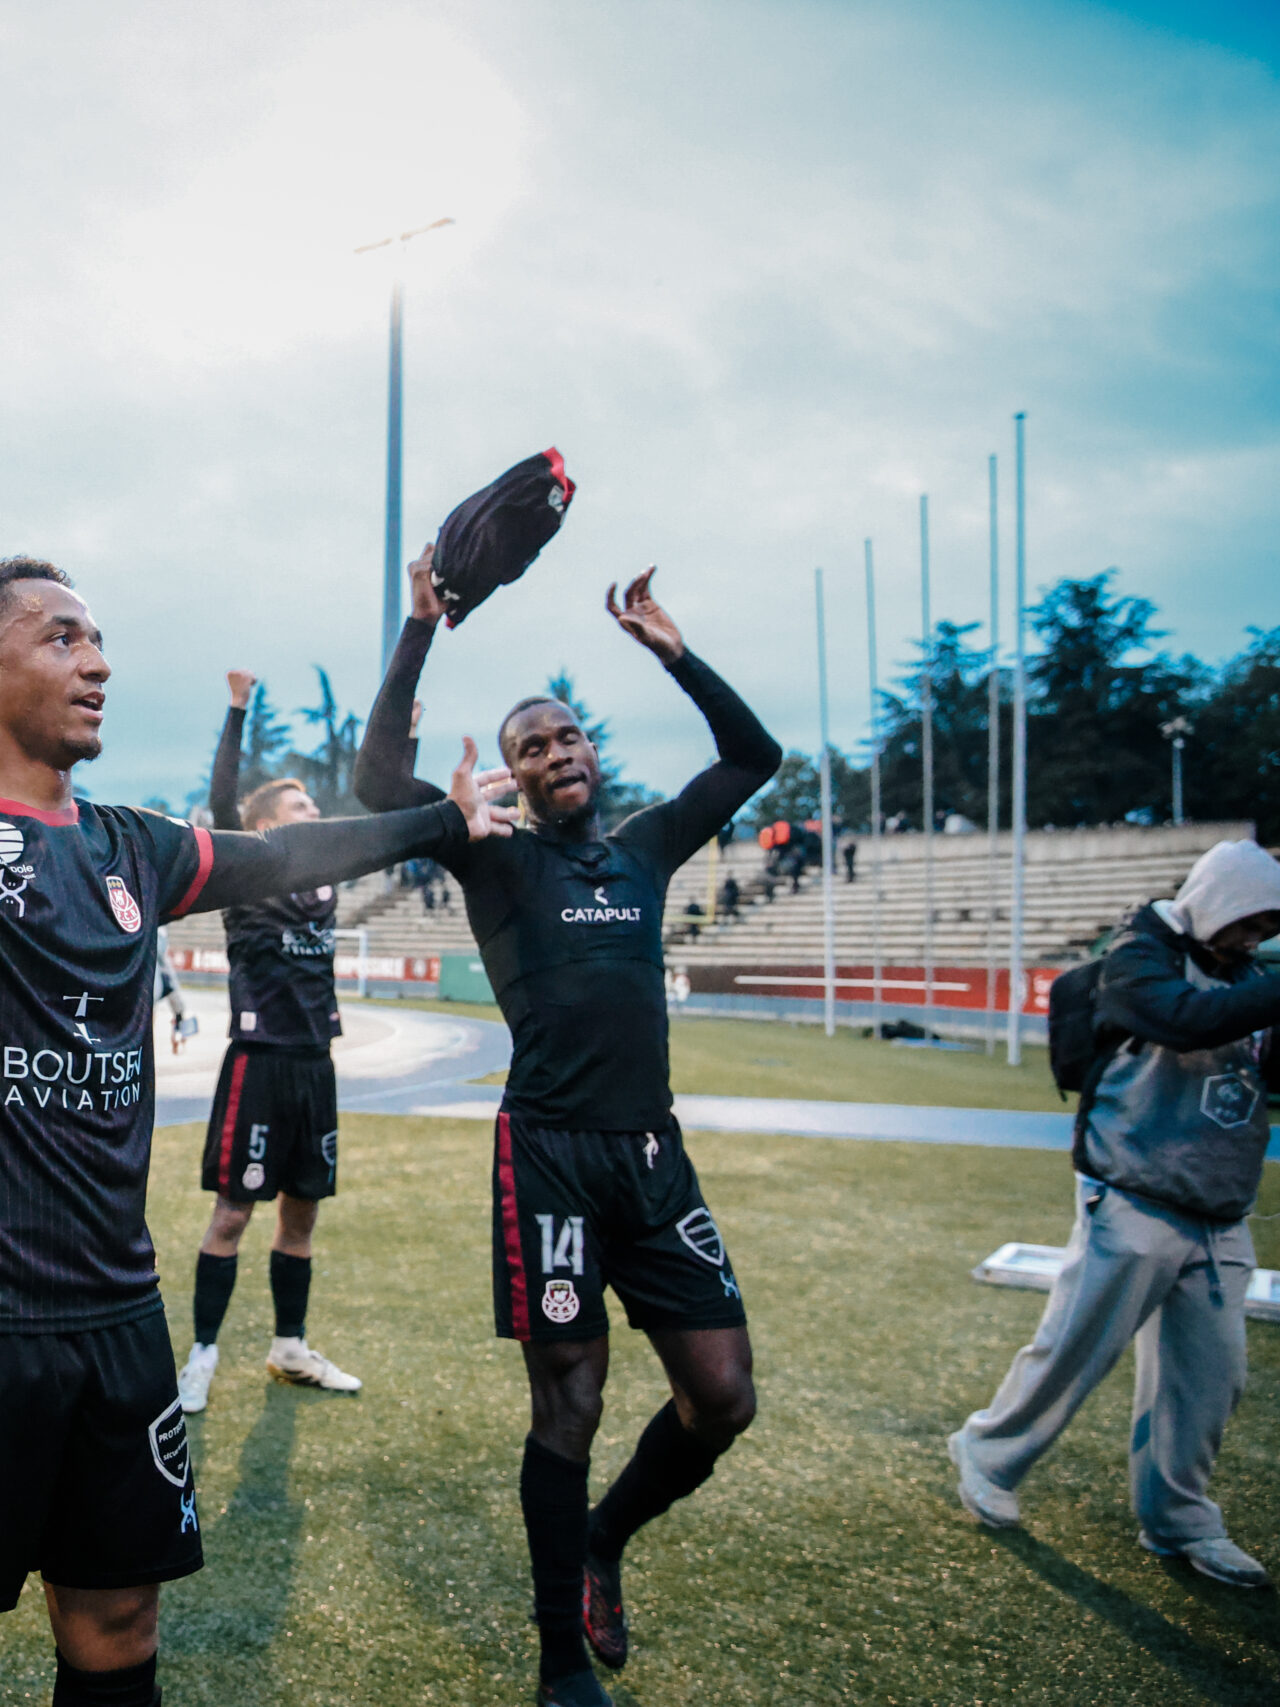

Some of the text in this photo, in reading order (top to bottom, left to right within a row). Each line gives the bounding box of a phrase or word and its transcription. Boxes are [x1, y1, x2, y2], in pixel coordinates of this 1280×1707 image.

[560, 907, 642, 922] CATAPULT
[3, 1046, 143, 1085] BOUTSEN
[4, 1082, 141, 1111] AVIATION
[248, 1123, 269, 1160] 5
[534, 1213, 584, 1276] 14
